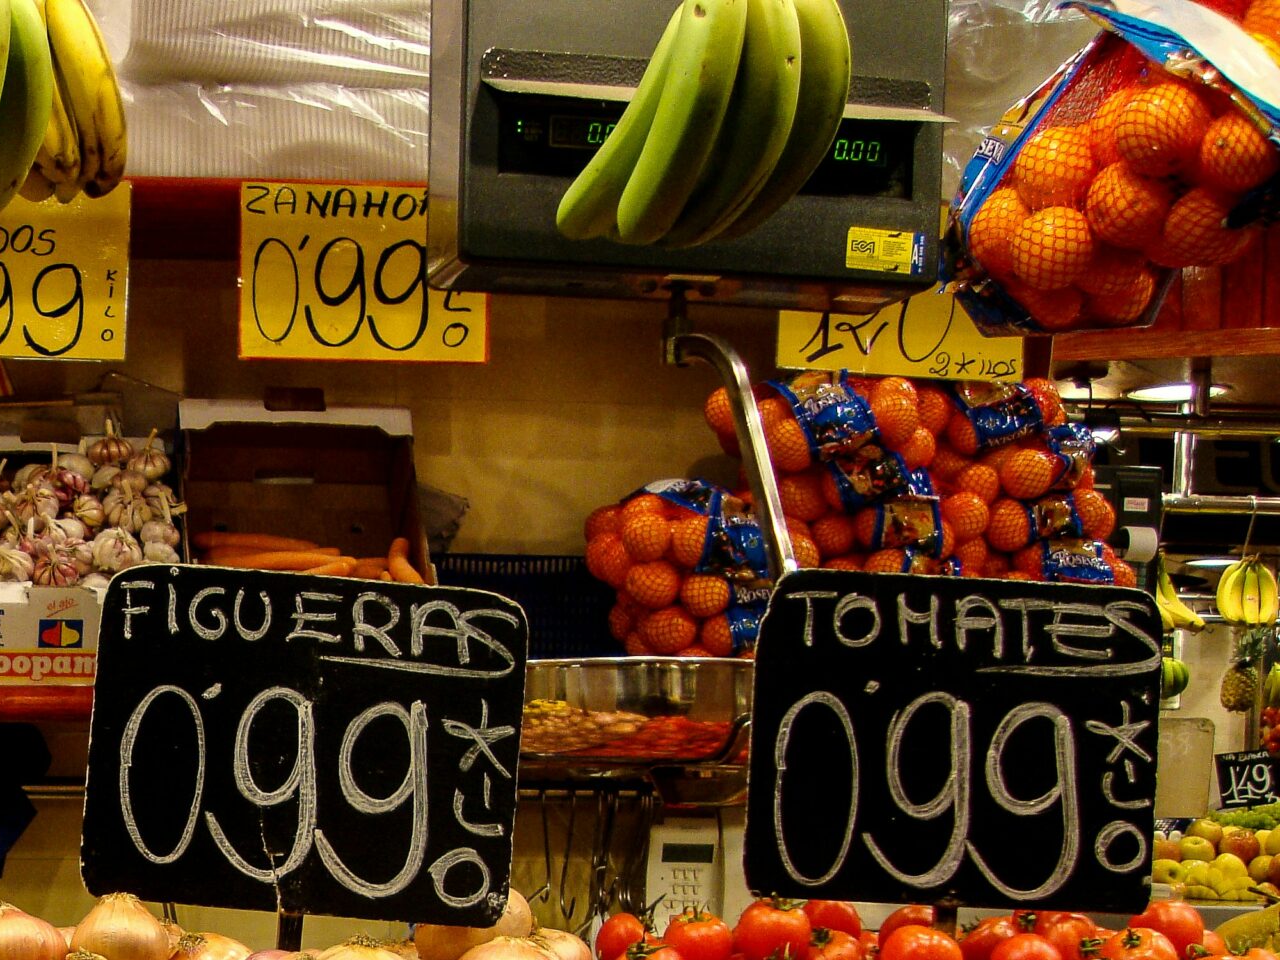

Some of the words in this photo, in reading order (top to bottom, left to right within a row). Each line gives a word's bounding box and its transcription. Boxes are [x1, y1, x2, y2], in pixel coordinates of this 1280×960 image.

[834, 139, 881, 162] 0.00
[246, 185, 428, 221] ZANAHO
[929, 352, 950, 377] 2
[120, 580, 519, 679] FIGUERAS
[785, 590, 1162, 677] TOMATES
[119, 683, 428, 899] 0'99
[774, 680, 1080, 900] 0'99
